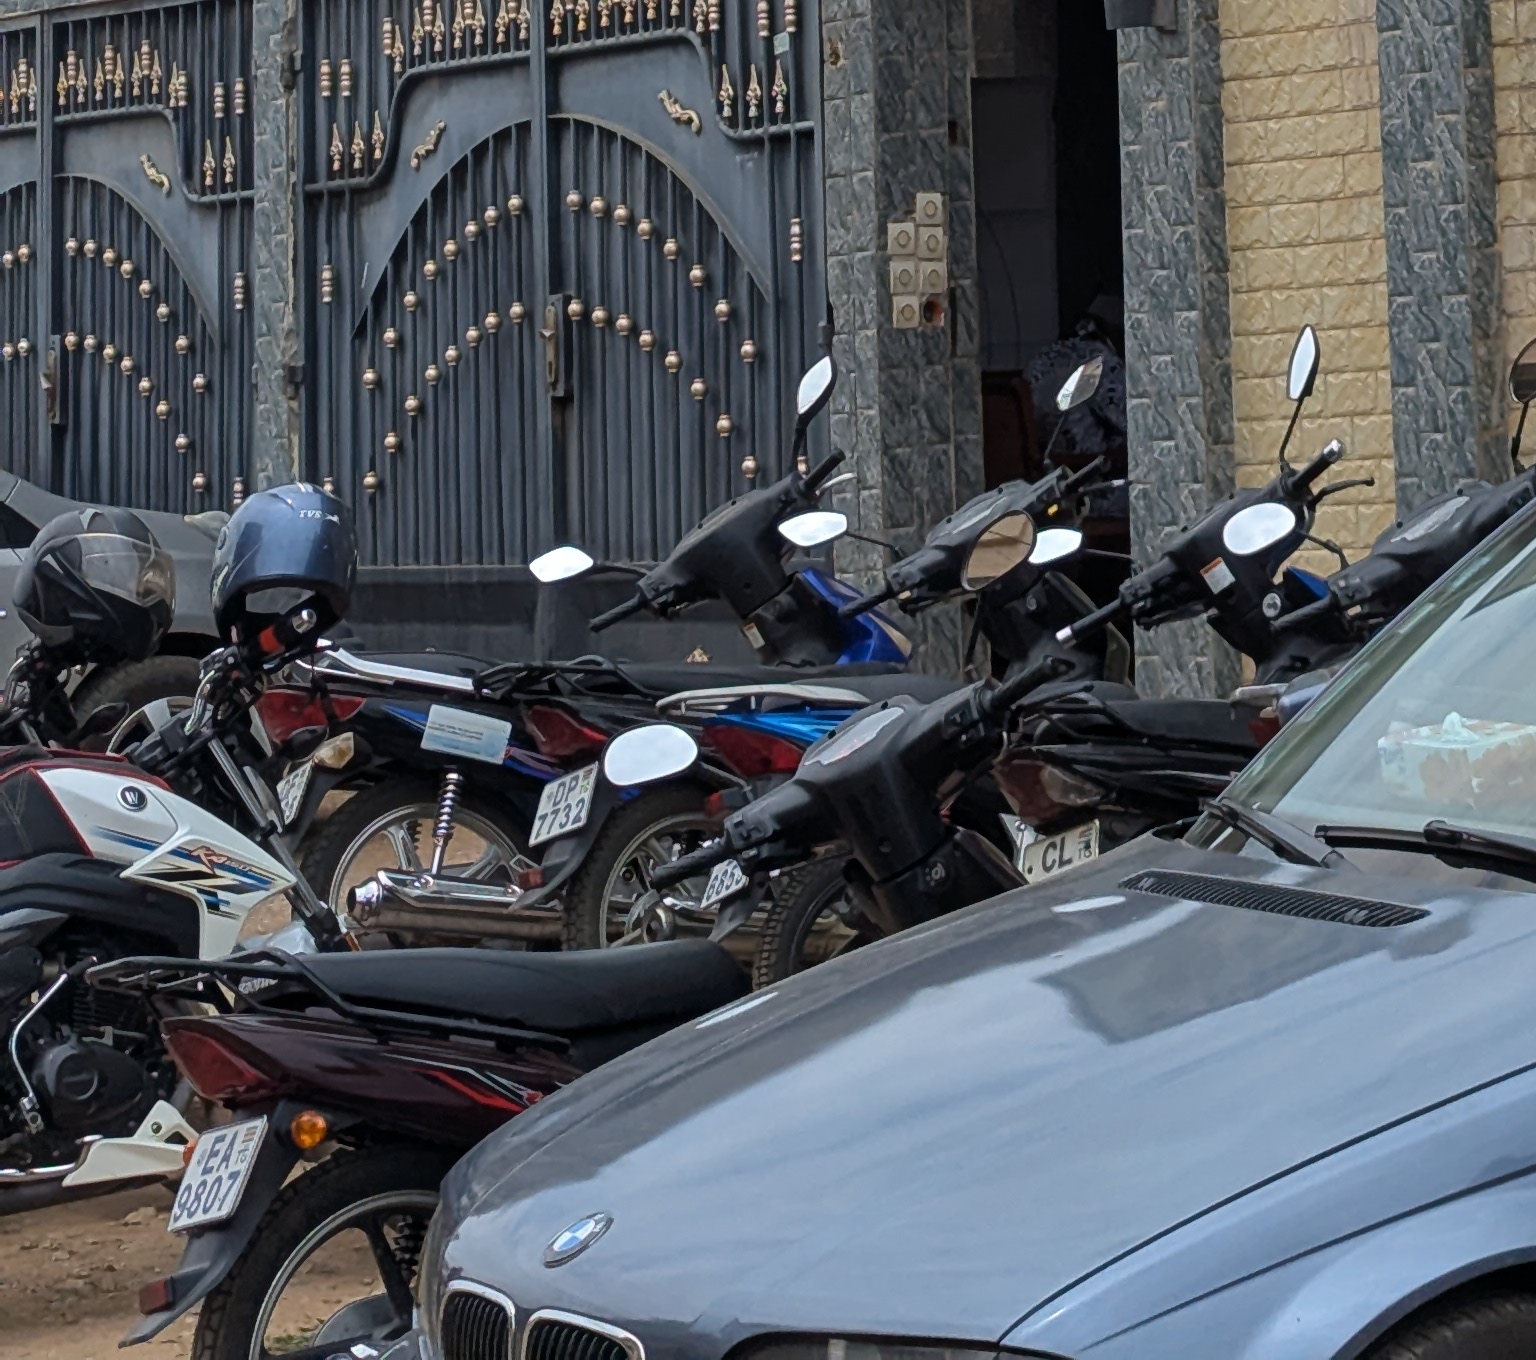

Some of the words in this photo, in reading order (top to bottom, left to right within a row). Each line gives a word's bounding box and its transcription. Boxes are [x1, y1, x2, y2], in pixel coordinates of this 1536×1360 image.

[552, 773, 580, 809] DP
[533, 796, 586, 841] 7732
[1041, 836, 1073, 874] CL
[200, 1129, 239, 1176] EA
[173, 1169, 241, 1223] 9807
